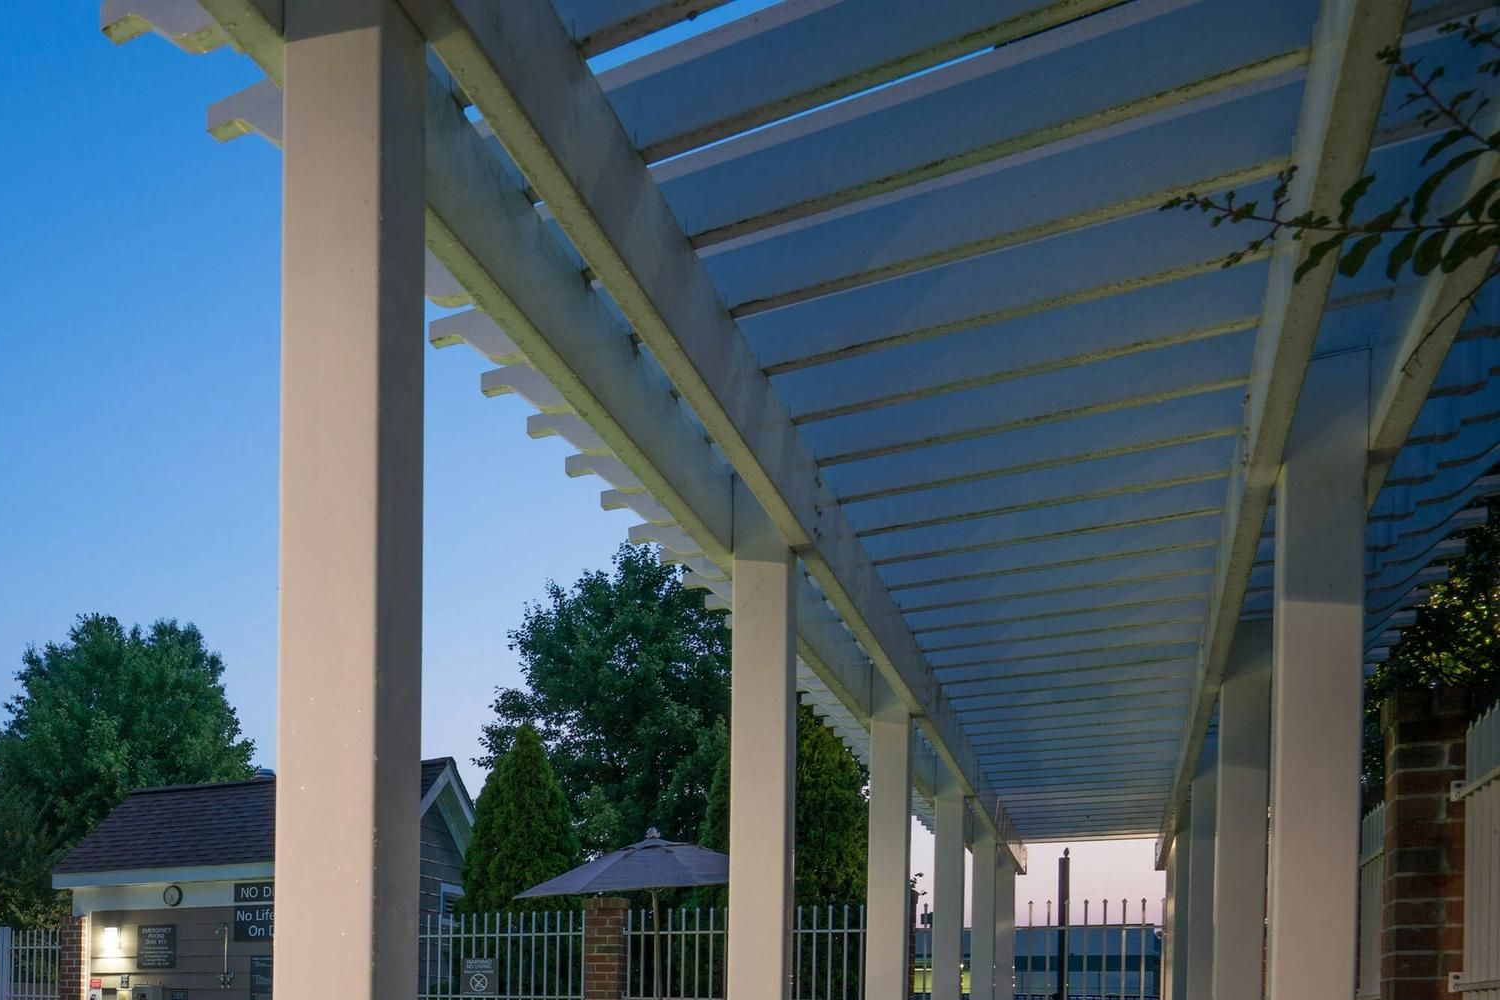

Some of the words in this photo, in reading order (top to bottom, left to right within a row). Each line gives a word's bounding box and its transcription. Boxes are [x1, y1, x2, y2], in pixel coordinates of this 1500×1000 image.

[240, 886, 259, 898] NO
[236, 909, 252, 921] No
[248, 925, 265, 937] On
